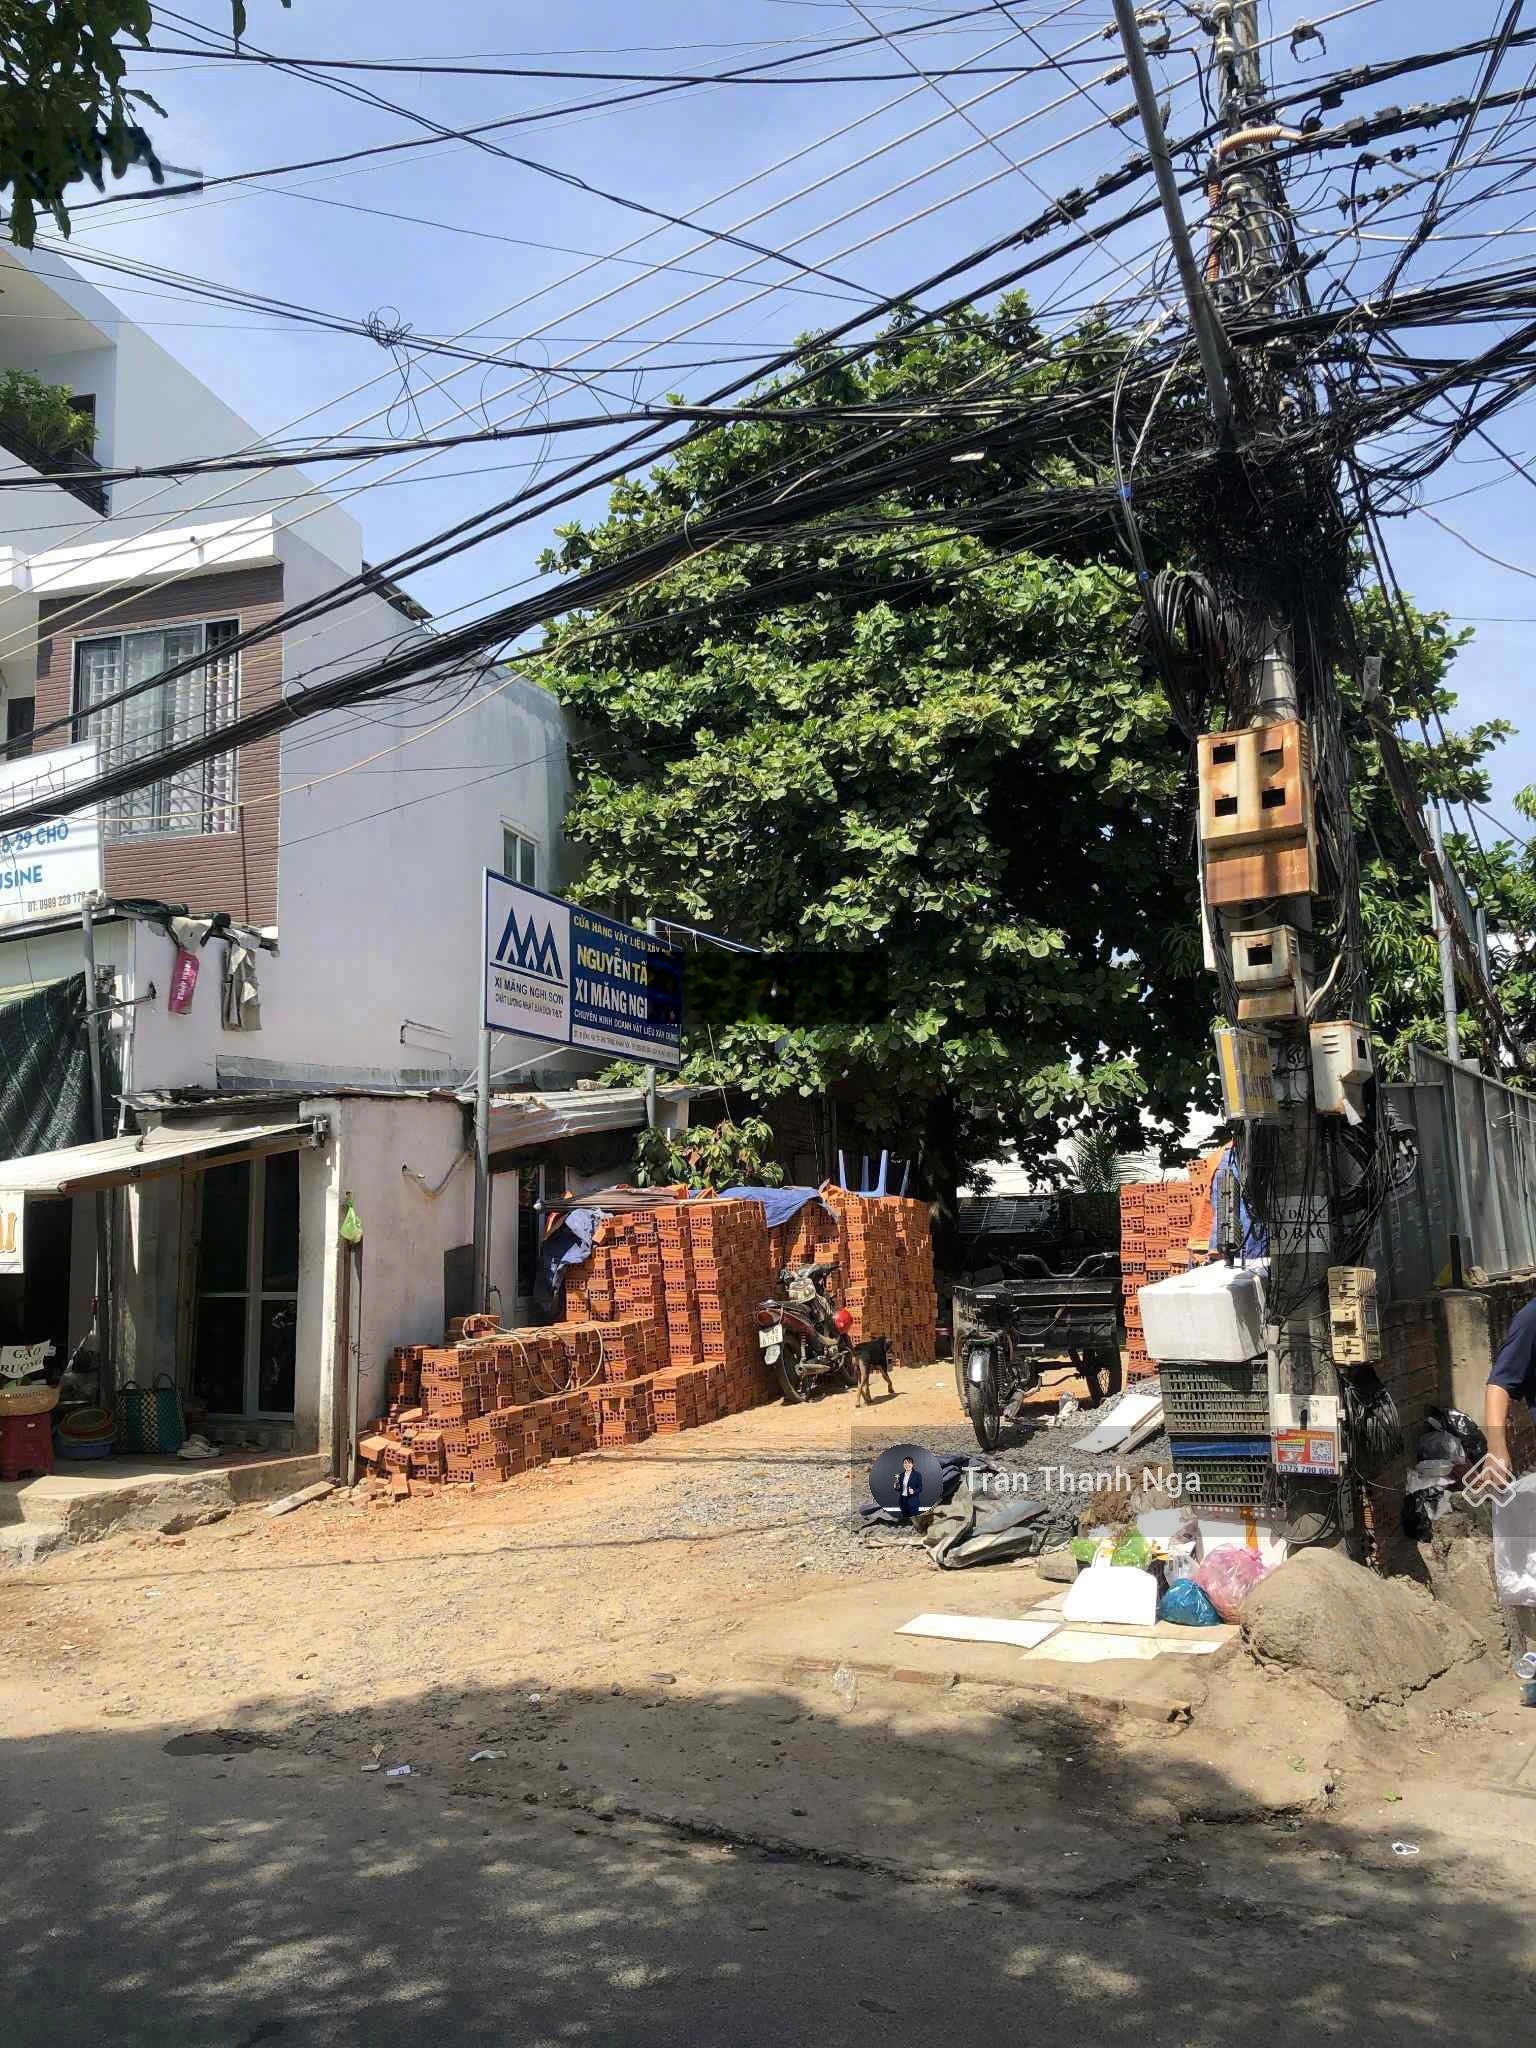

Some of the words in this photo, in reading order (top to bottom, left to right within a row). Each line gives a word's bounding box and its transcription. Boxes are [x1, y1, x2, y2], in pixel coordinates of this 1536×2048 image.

[0, 864, 43, 890] SINE
[573, 914, 589, 929] CỬA
[592, 921, 613, 939] HÀNG
[615, 930, 629, 945] VẬT
[577, 944, 632, 981] NGUYỄN
[495, 975, 502, 988] XI
[504, 978, 528, 996] MĂNG
[529, 985, 547, 1001] NGHI
[575, 977, 588, 1004] XI
[591, 981, 627, 1015] MĂNG
